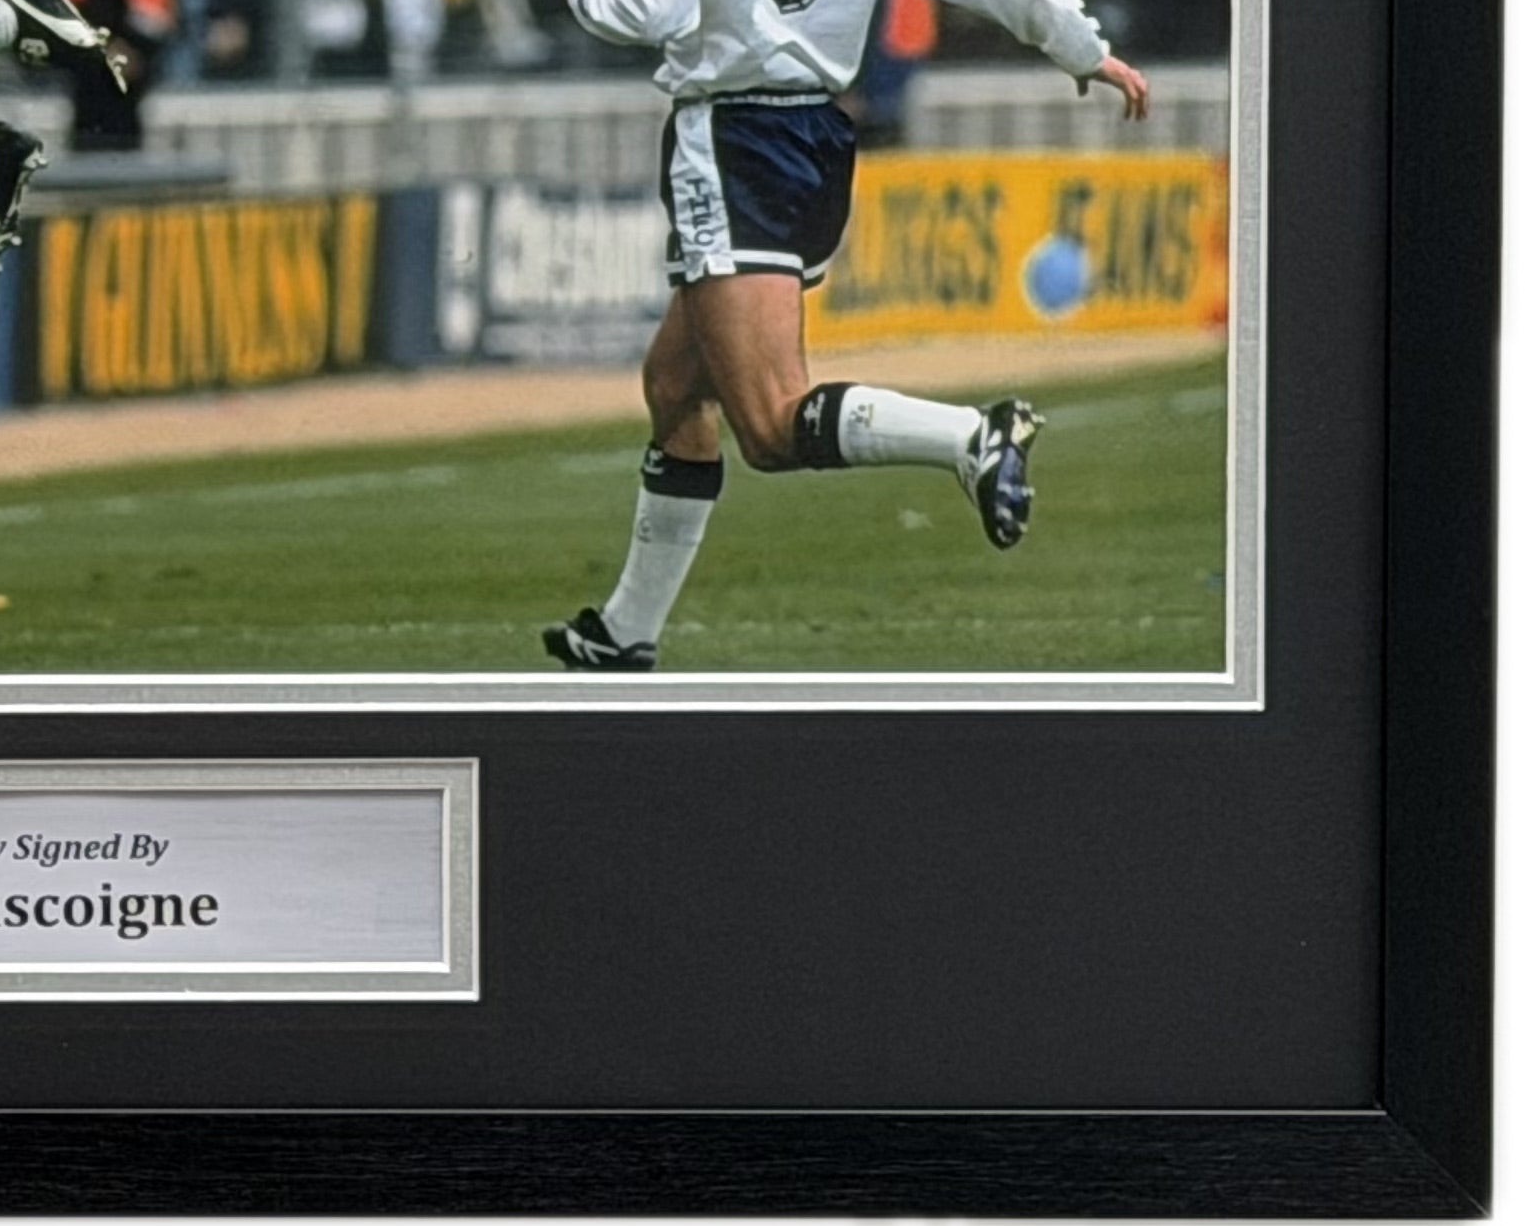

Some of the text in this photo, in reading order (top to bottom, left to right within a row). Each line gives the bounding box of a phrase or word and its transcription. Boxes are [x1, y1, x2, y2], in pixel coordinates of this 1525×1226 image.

[685, 177, 717, 247] THFC
[12, 832, 122, 868] Signed
[129, 832, 171, 867] By
